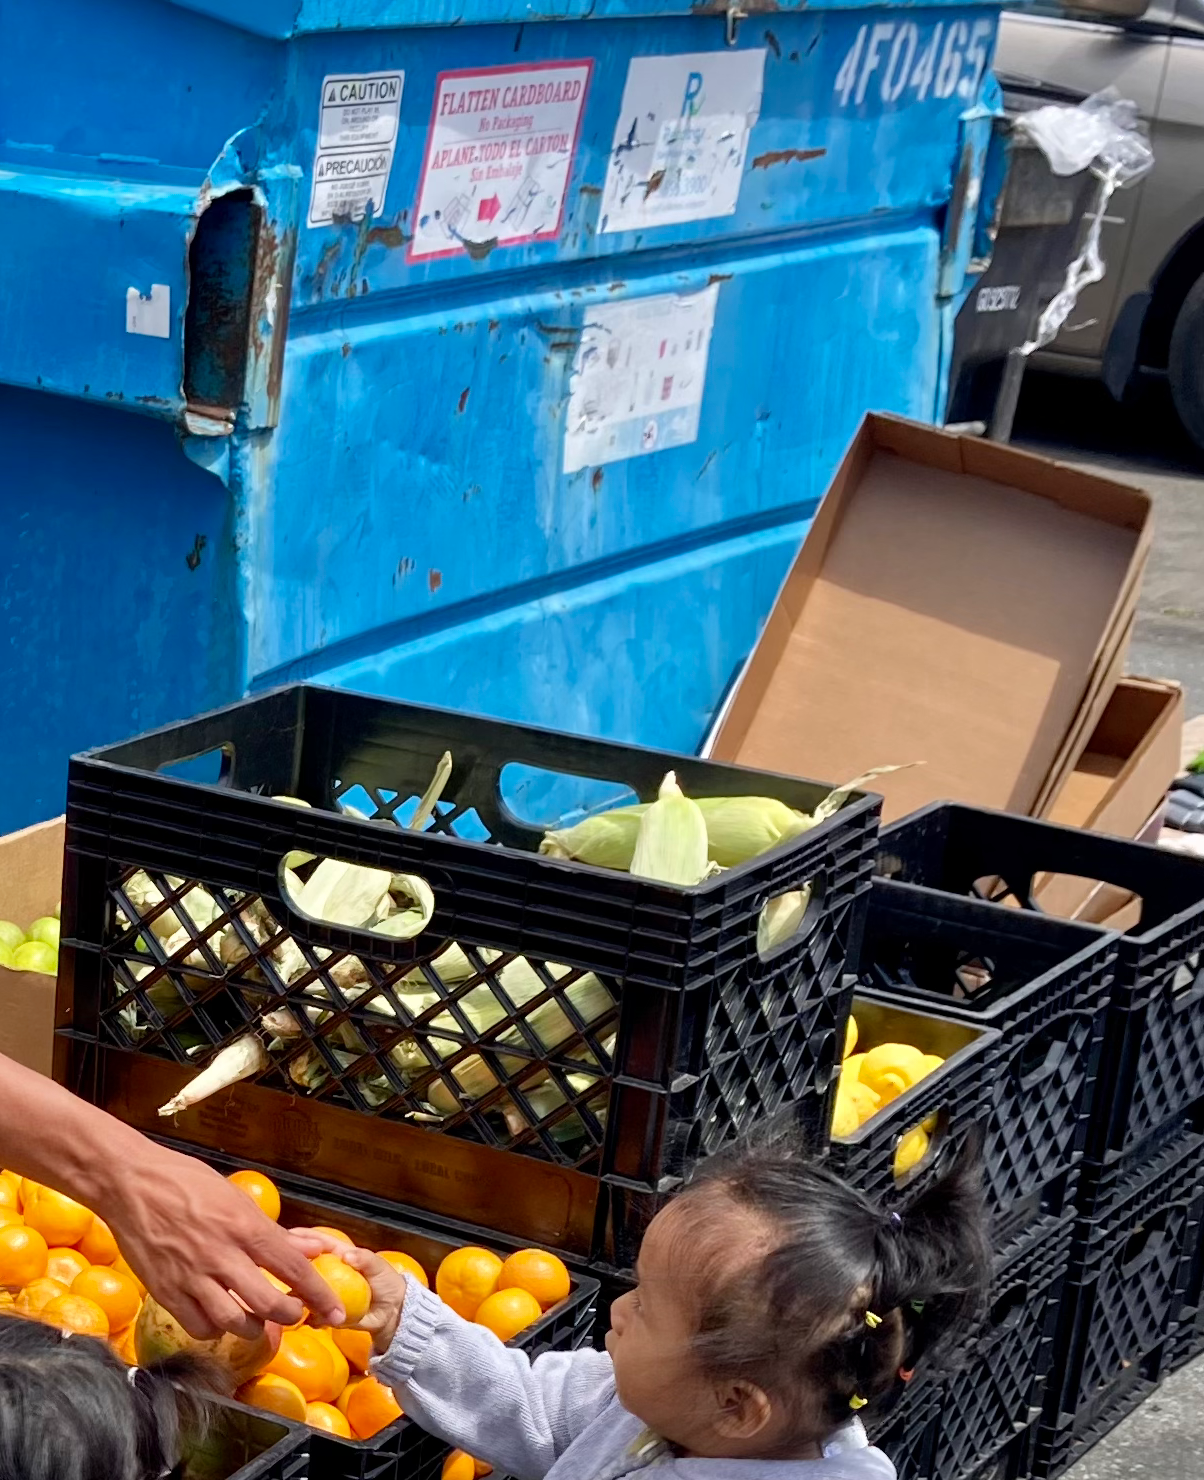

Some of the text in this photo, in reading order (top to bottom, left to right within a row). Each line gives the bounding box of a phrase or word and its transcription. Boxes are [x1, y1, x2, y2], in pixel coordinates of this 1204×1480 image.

[339, 80, 397, 102] CAUTION
[440, 79, 582, 116] FLATTEN CARDBOARD
[478, 115, 535, 133] No Packaging
[431, 133, 570, 170] APLANE TODO EL CARTON
